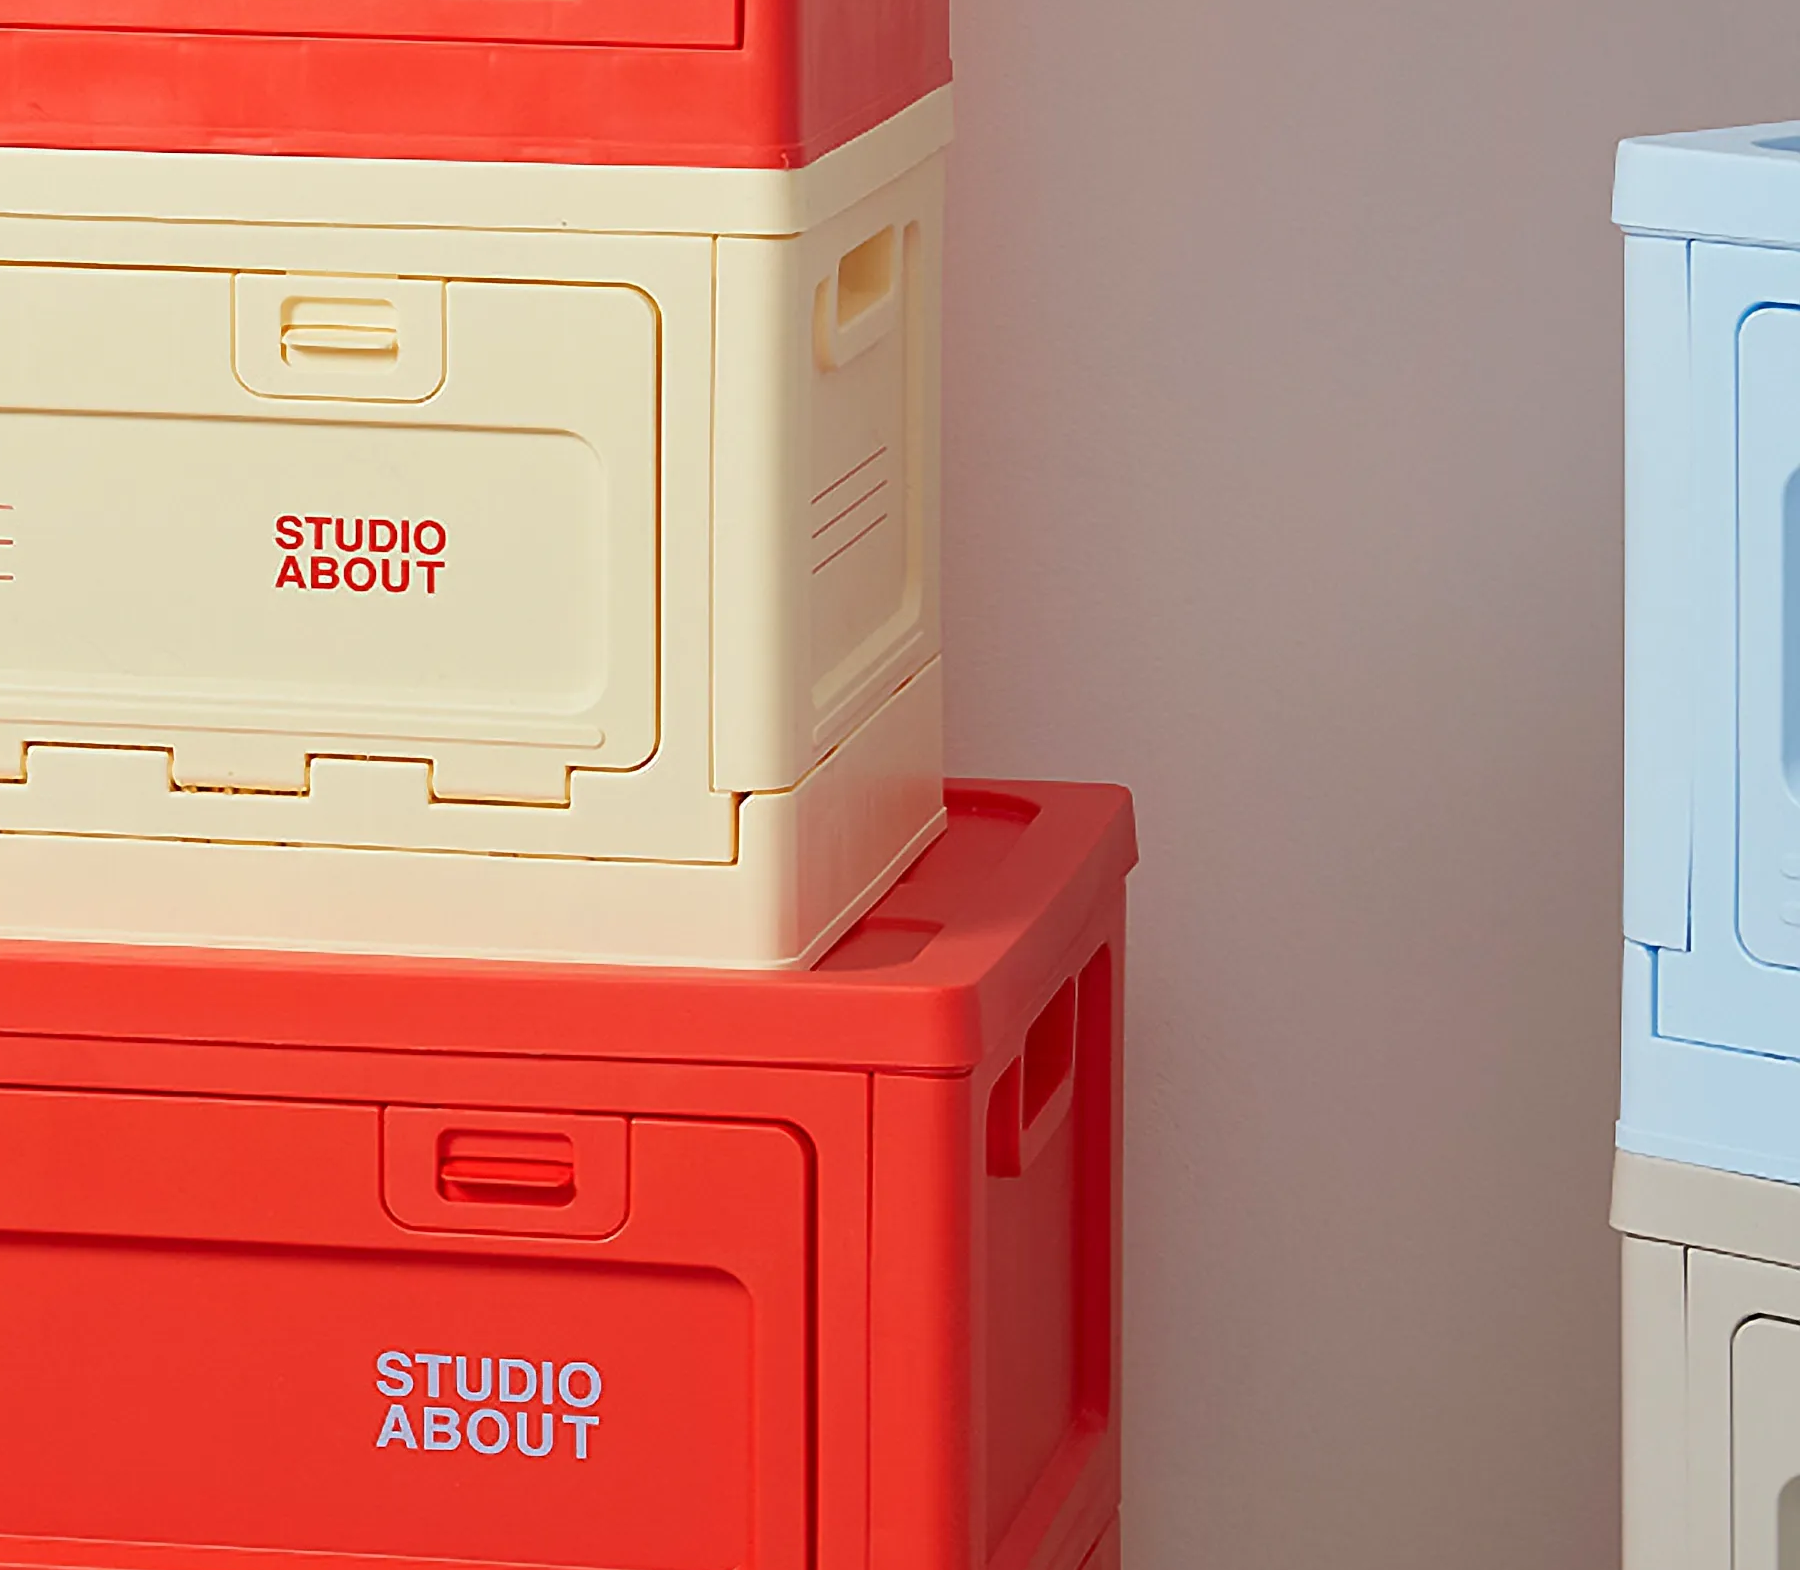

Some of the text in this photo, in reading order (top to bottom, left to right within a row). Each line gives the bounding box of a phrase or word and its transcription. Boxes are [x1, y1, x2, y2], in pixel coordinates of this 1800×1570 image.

[274, 514, 447, 556] STUDIO
[275, 555, 446, 594] ABOUT
[376, 1350, 602, 1408] STUDIO
[376, 1403, 600, 1459] ABOUT
